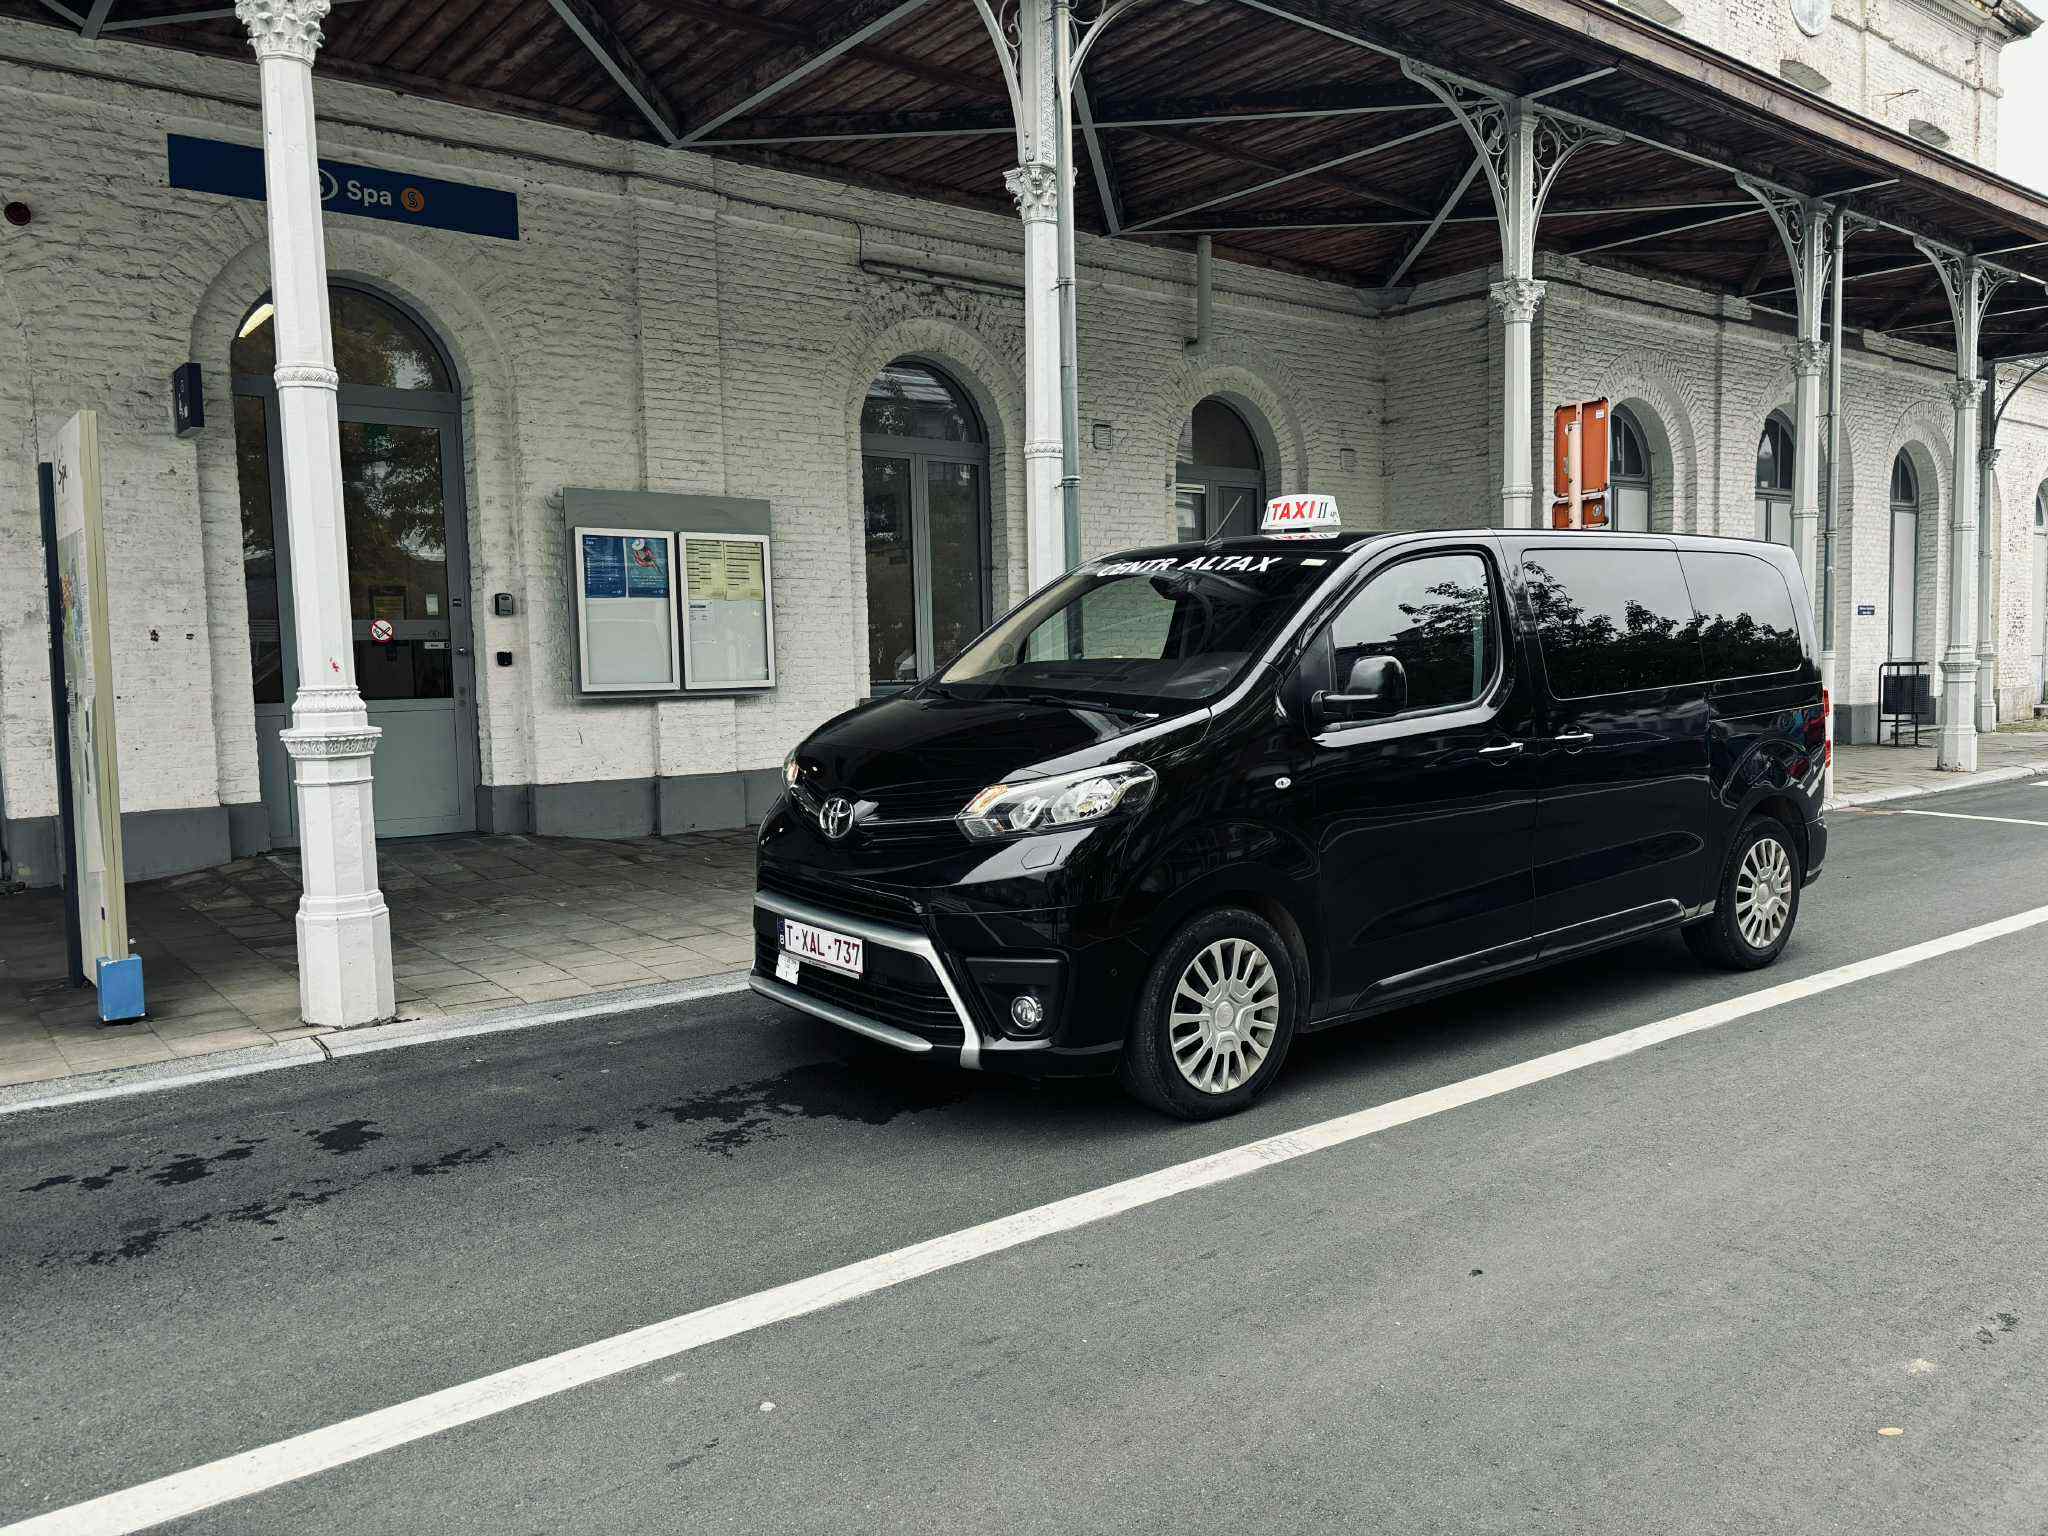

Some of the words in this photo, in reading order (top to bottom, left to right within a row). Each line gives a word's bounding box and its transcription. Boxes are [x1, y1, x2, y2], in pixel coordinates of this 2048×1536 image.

[347, 180, 392, 207] Spa
[1272, 500, 1316, 521] TAXI
[1097, 558, 1179, 577] CENTR
[1177, 556, 1283, 572] ALTAX
[786, 924, 860, 966] T-XAL-737
